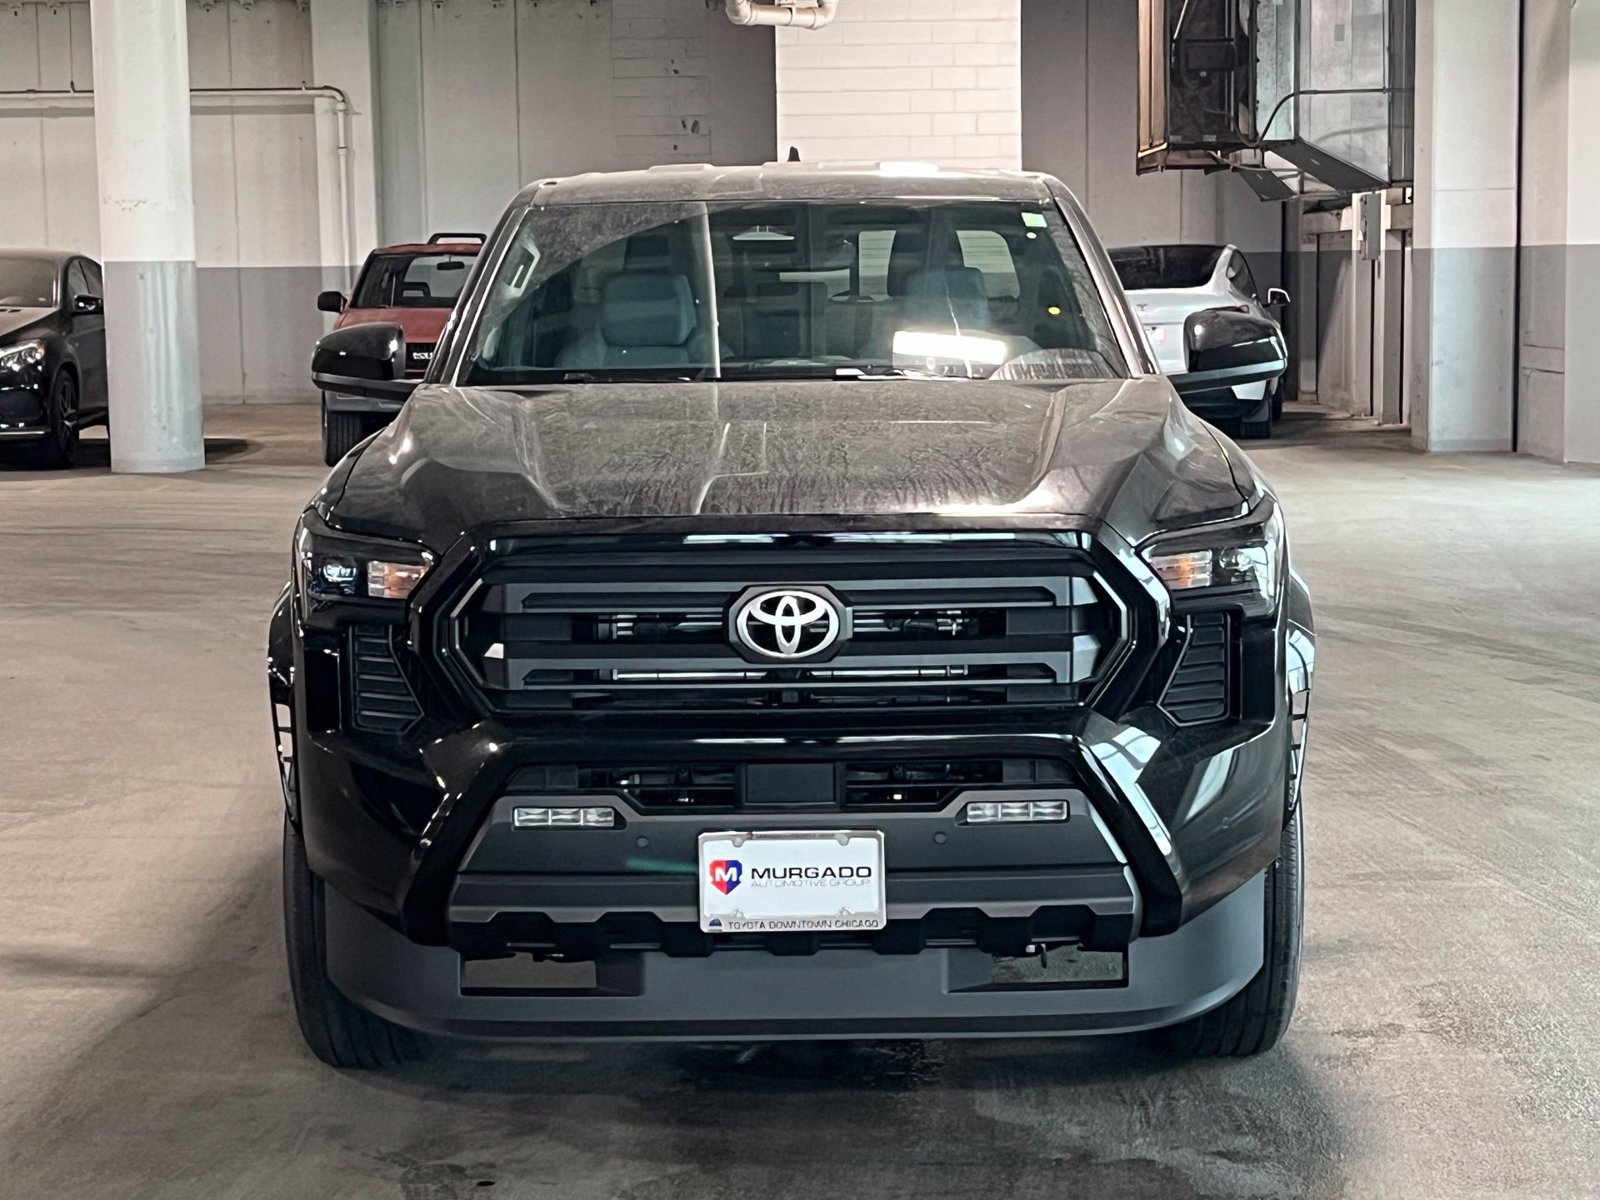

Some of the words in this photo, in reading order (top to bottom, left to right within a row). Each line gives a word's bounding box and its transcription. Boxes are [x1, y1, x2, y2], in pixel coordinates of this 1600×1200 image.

[715, 867, 738, 882] M
[751, 866, 872, 879] MURGADO
[751, 878, 828, 888] AUTOMOTIVE
[829, 878, 871, 887] GROUP
[728, 921, 766, 930] TOYOTA
[769, 920, 832, 930] DOWNTOWN
[835, 919, 879, 929] CHICAGO
